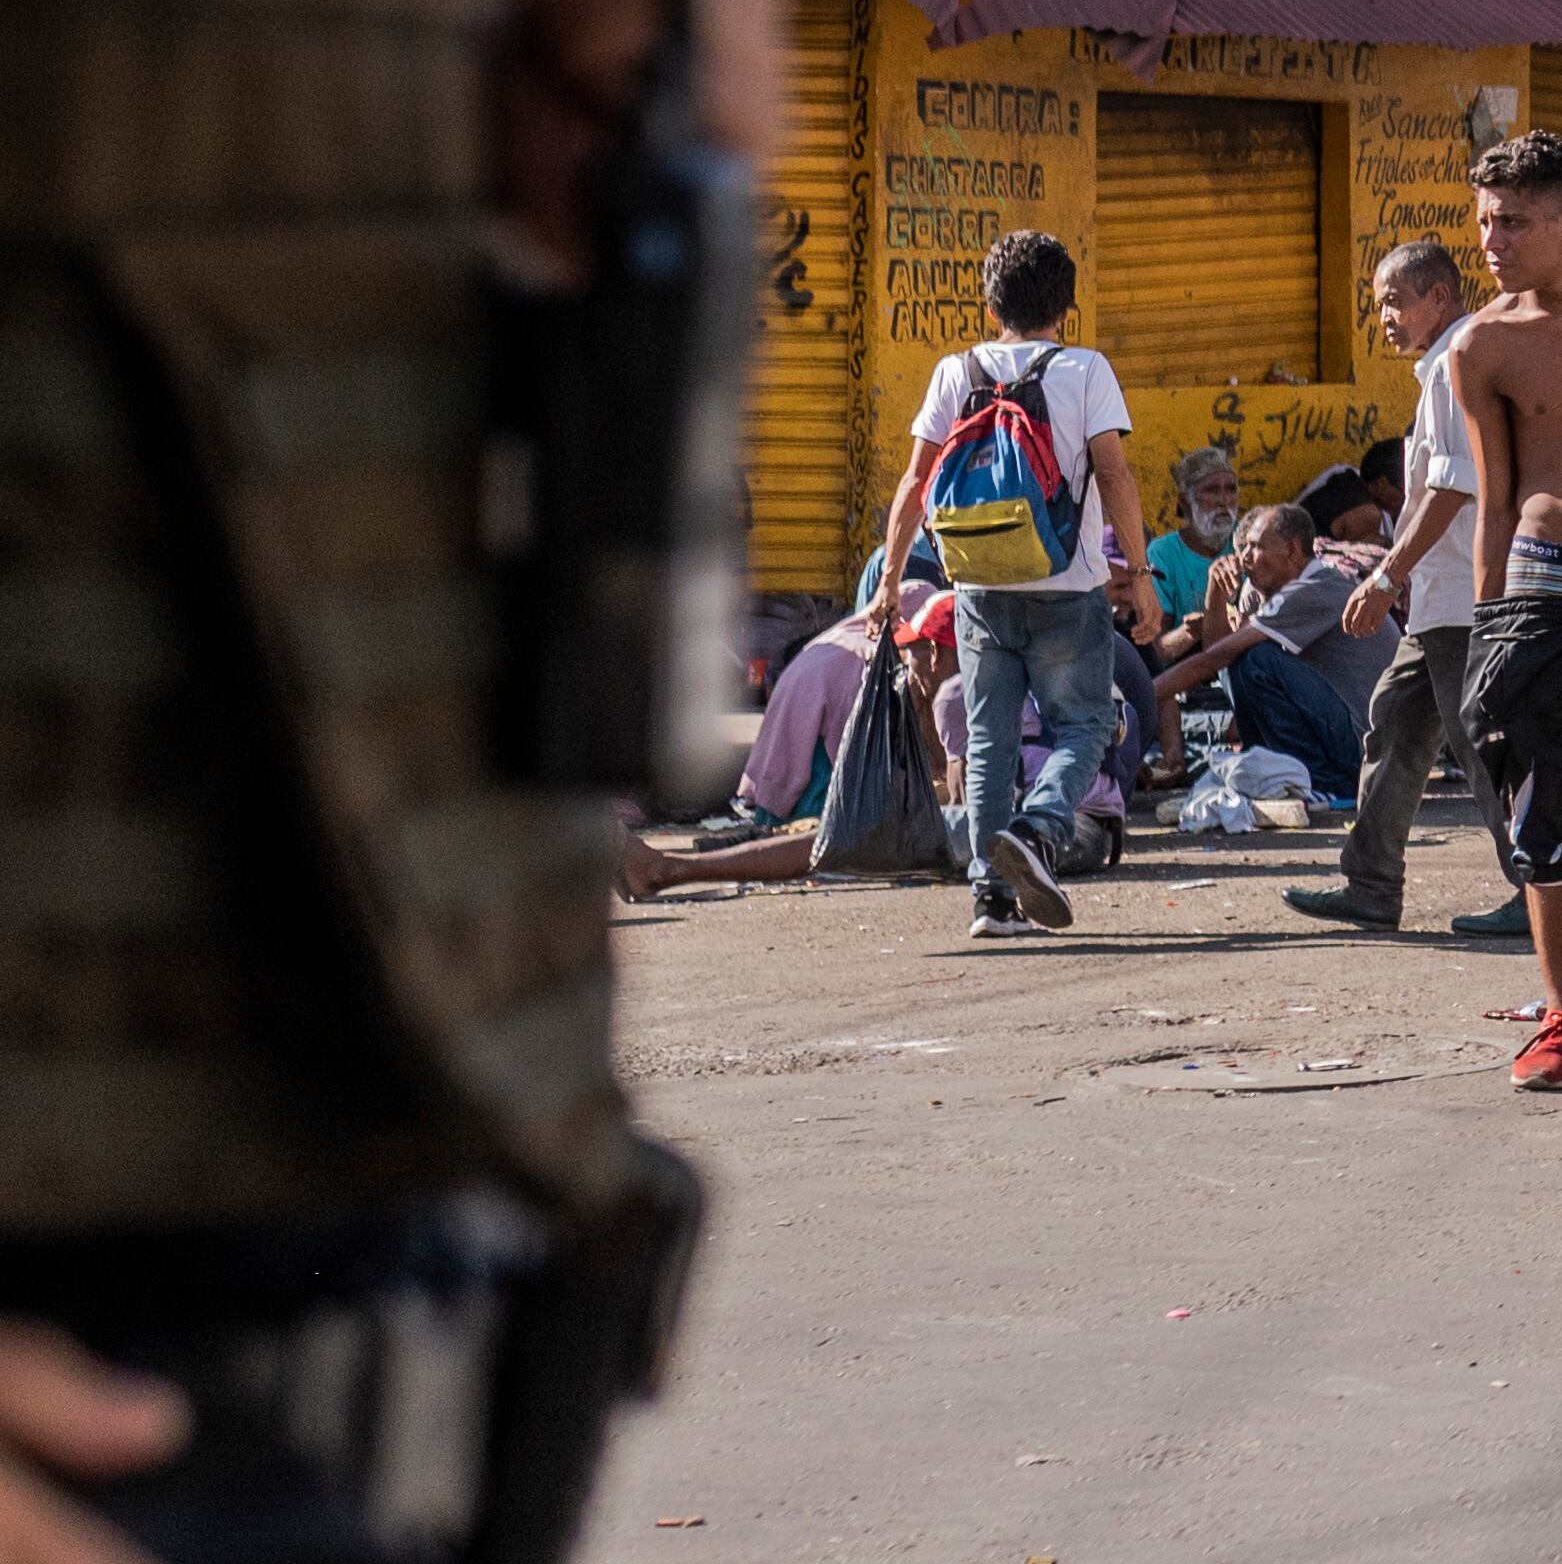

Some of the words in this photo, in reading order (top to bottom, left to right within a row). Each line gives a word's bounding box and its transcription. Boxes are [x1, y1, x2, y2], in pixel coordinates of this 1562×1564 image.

[1161, 31, 1382, 86] AREJITA
[885, 153, 1045, 201] CHATARRA
[886, 207, 1000, 252] COBRE
[850, 171, 870, 381] CASERAS
[888, 258, 985, 299] ALUM
[1512, 539, 1560, 558] ewboat
